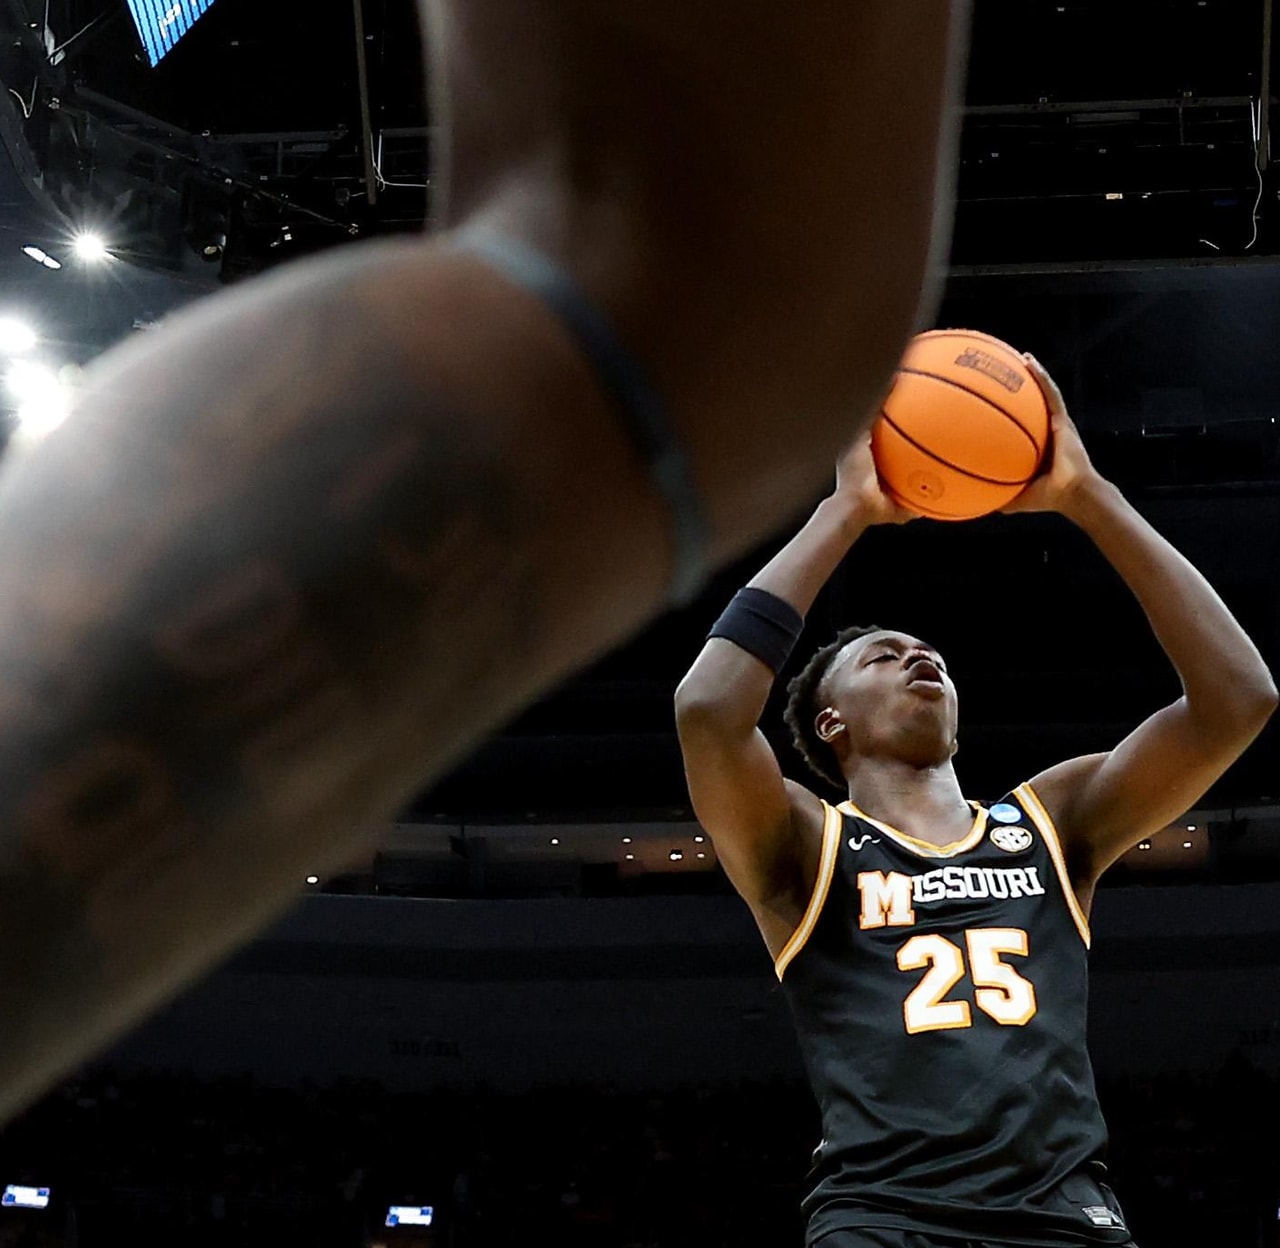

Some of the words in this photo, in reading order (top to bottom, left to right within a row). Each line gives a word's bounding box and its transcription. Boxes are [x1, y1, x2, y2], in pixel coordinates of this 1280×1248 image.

[991, 826, 1031, 852] SEC
[857, 866, 1045, 929] MISSOURI
[896, 928, 1037, 1034] 25
